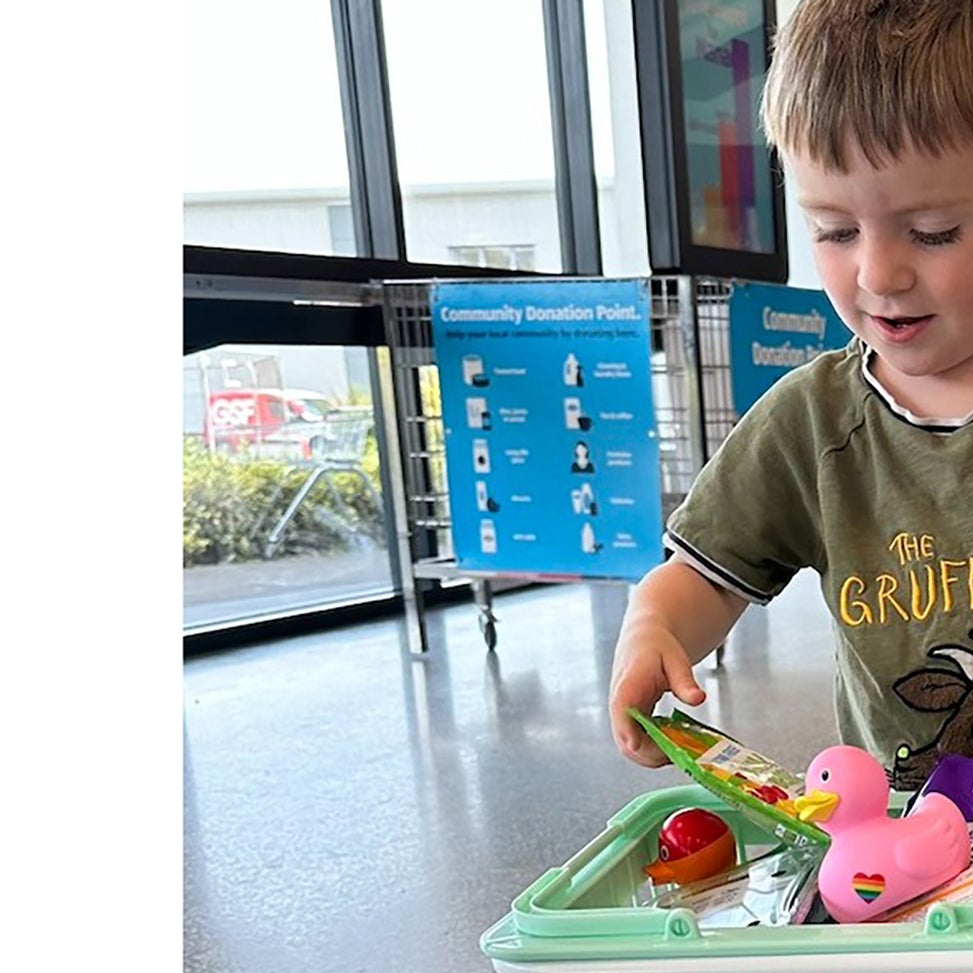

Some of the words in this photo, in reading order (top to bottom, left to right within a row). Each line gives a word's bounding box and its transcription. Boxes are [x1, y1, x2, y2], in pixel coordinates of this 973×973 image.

[440, 305, 523, 325] Community
[525, 303, 594, 321] Donation
[596, 303, 642, 321] Point.
[762, 306, 827, 340] Community
[752, 340, 806, 367] Donation
[888, 532, 935, 566] THE
